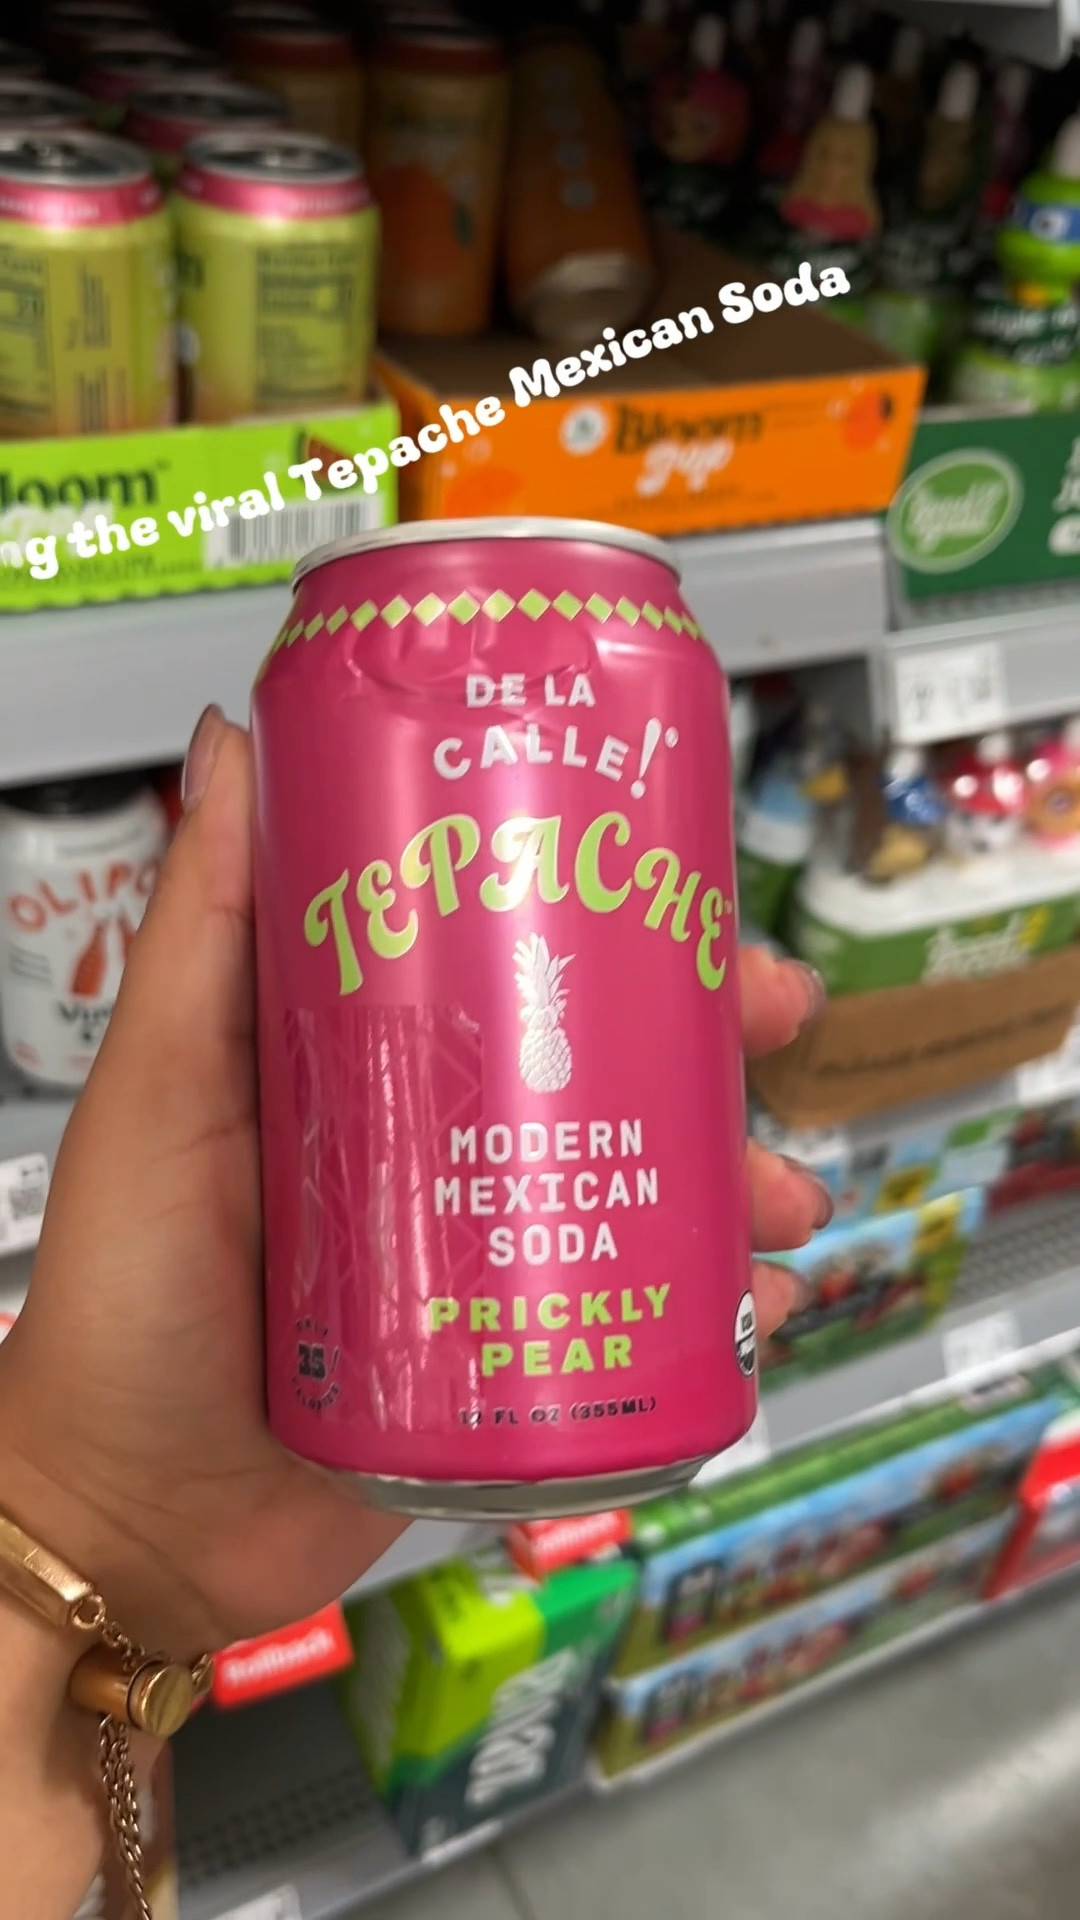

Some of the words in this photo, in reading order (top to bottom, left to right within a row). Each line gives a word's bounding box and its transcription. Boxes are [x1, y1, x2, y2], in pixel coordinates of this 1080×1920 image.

[466, 673, 527, 708] DE
[544, 673, 596, 708] LA
[303, 811, 728, 996] TEPACHE
[450, 1119, 643, 1165] MODERN
[434, 1168, 659, 1216] MEXICAN
[488, 1222, 618, 1267] SODA
[428, 1284, 671, 1333] PRICKLY
[481, 1335, 633, 1377] PEAR
[459, 1404, 482, 1426] 12
[494, 1406, 519, 1425] FL
[530, 1404, 561, 1424] OZ
[570, 1396, 656, 1420] (355ML)
